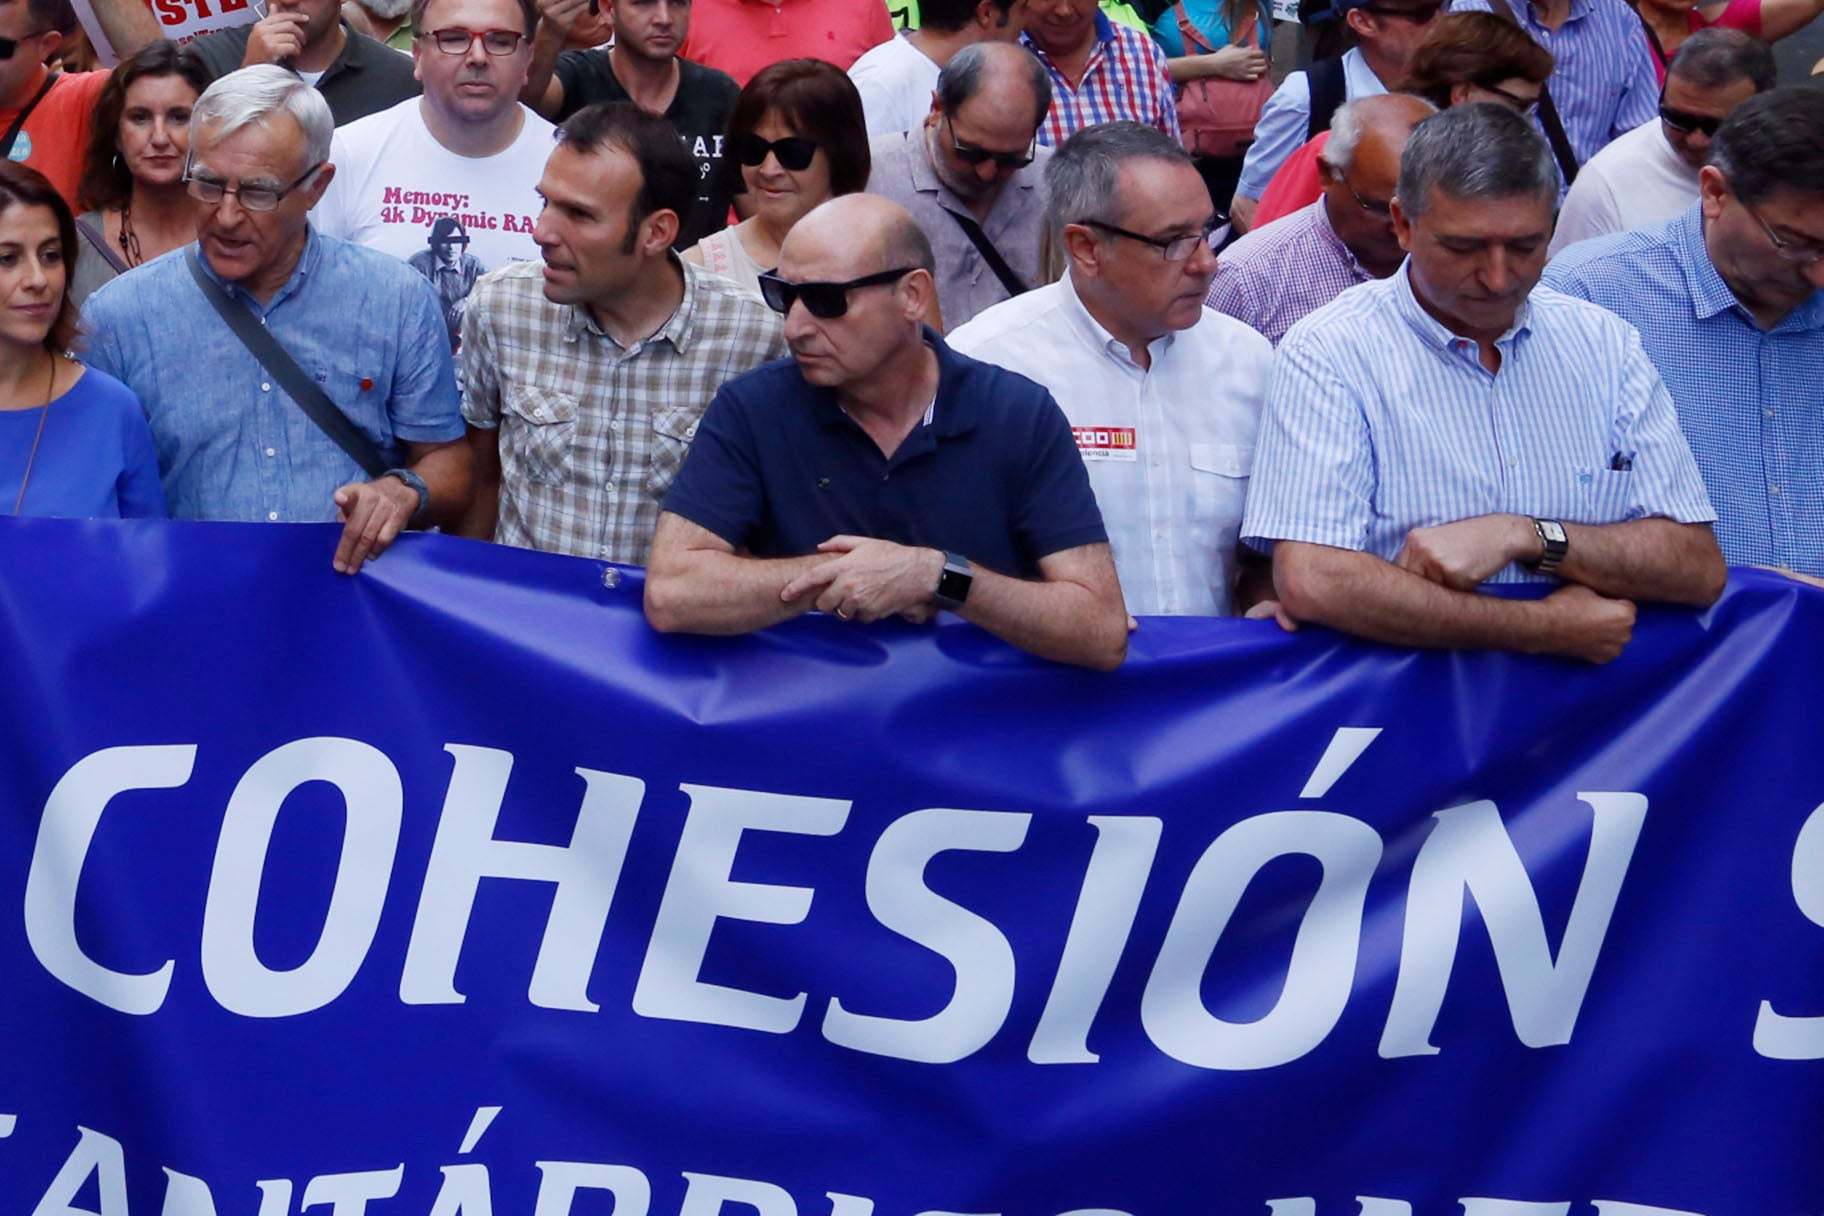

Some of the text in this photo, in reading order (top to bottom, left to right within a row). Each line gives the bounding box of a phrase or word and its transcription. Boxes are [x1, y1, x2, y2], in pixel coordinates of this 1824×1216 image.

[384, 186, 470, 208] Memory:
[503, 214, 542, 234] RA
[23, 726, 1651, 1072] COHESIÓN
